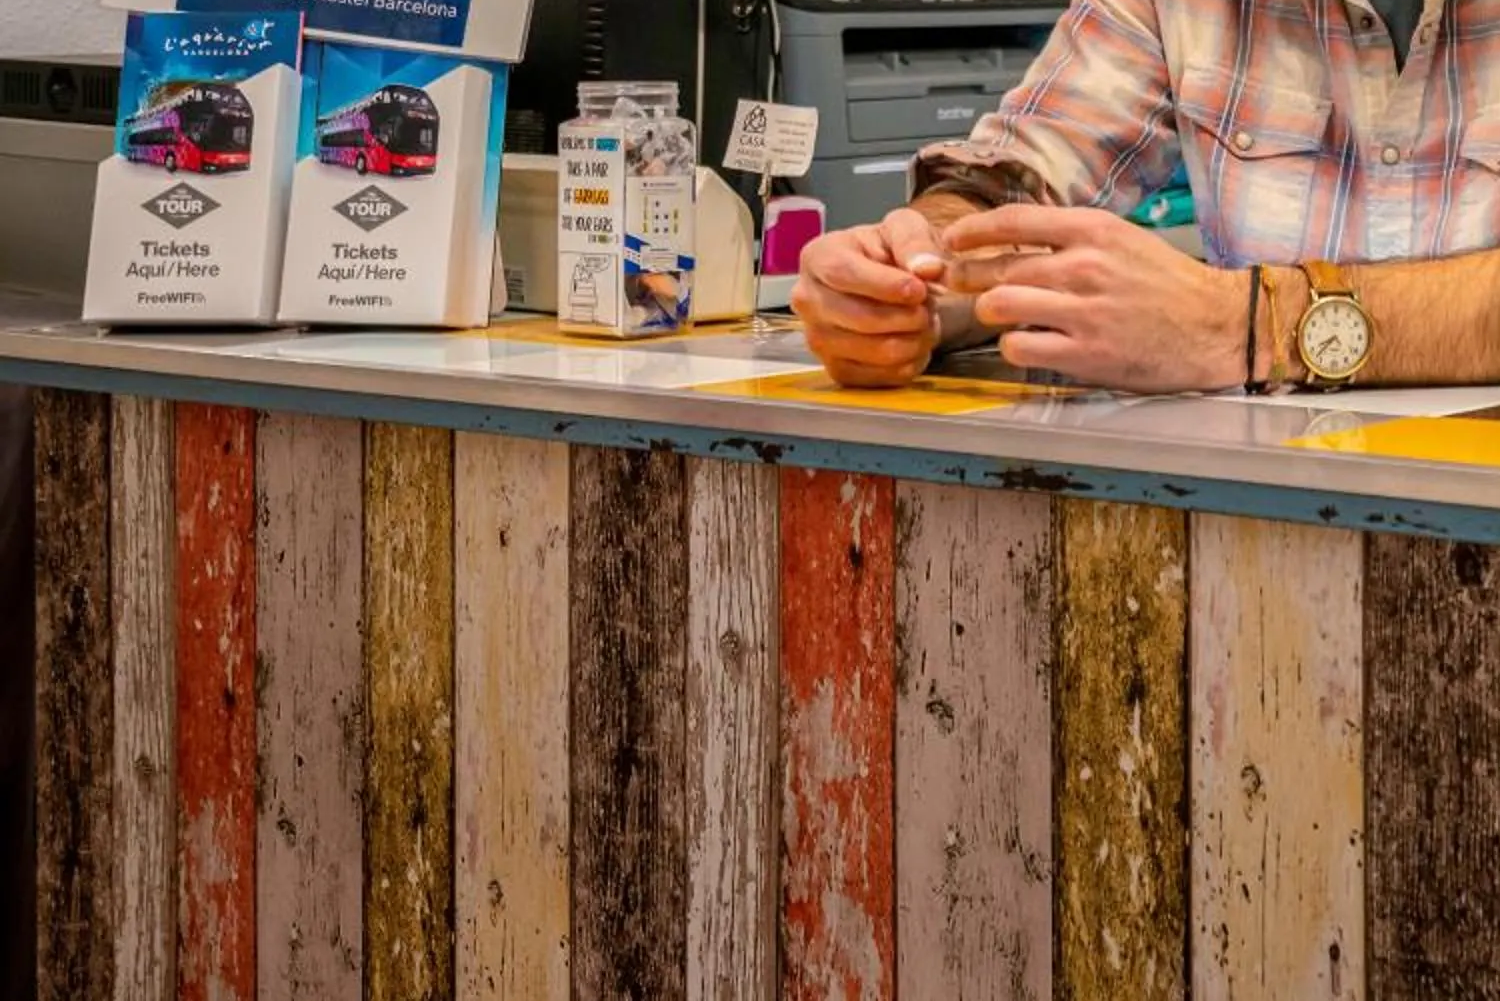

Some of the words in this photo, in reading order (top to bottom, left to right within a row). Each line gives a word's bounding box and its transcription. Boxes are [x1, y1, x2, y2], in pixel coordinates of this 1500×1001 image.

[157, 200, 203, 214] TOUR
[347, 202, 392, 216] TOUR
[140, 240, 210, 257] Tickets
[332, 243, 398, 259] Tickets
